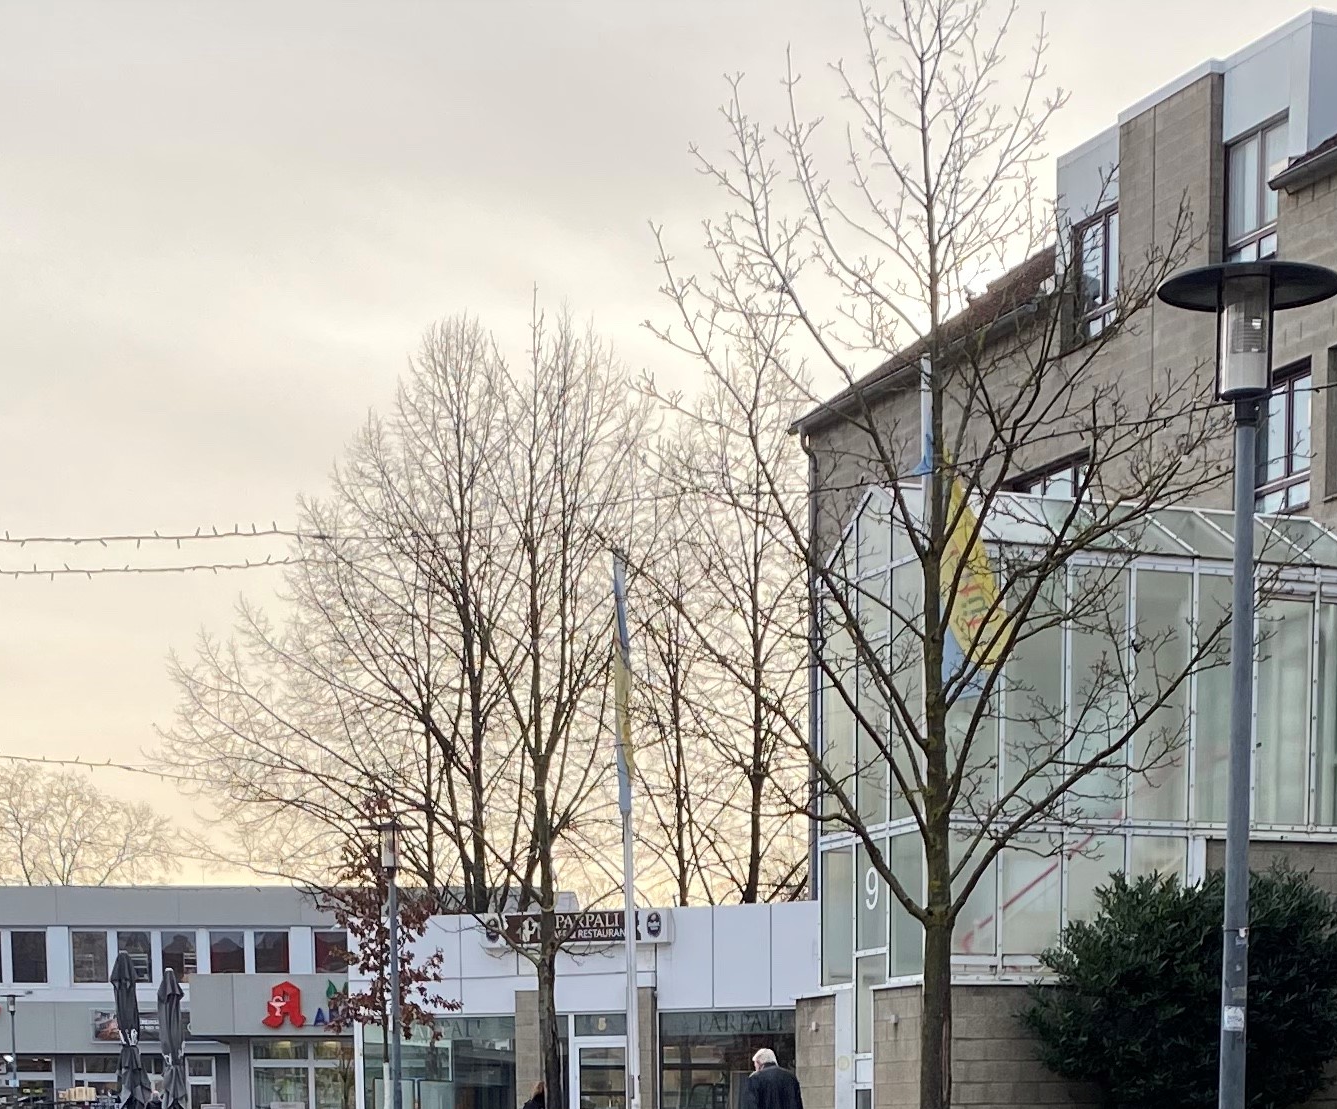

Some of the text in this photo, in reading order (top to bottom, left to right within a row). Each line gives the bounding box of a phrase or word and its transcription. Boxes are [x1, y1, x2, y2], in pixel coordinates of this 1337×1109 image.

[865, 866, 879, 911] 9
[555, 912, 620, 930] PARPALI
[577, 928, 627, 939] RESTAURAN
[698, 1012, 784, 1033] PARPALI
